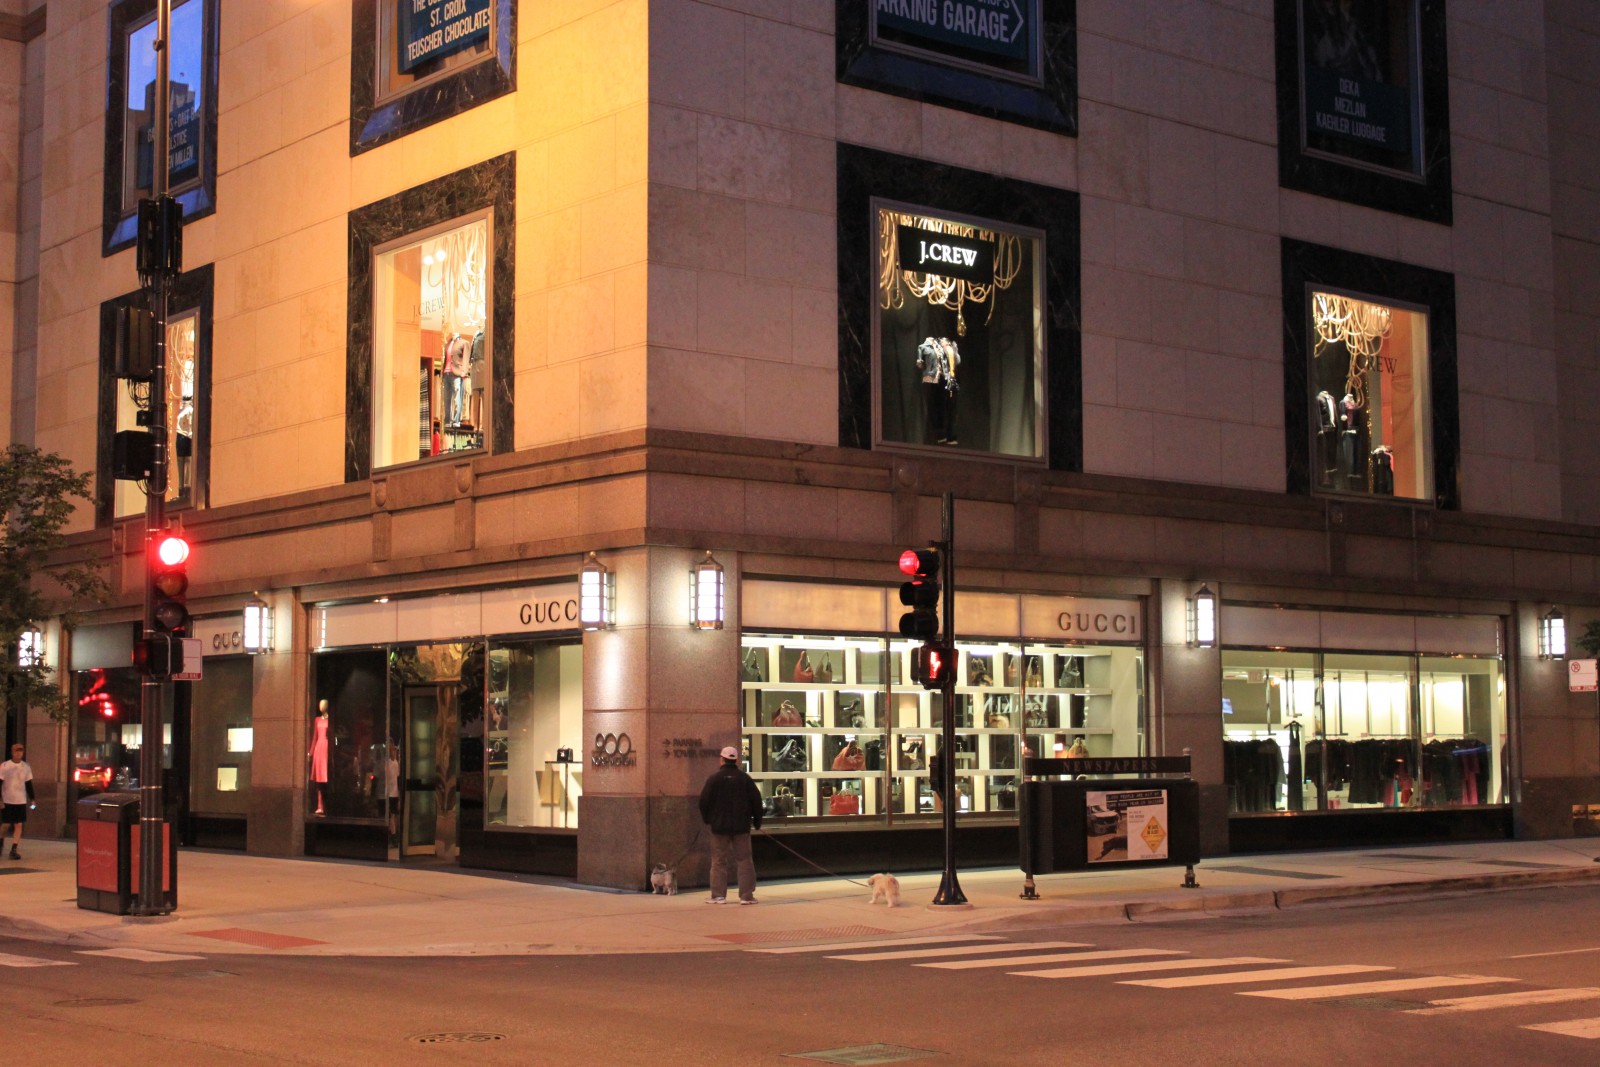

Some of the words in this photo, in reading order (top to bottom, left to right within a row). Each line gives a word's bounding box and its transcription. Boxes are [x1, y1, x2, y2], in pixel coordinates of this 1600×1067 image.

[430, 7, 442, 28] ST.
[444, 0, 467, 21] CROIX
[943, 0, 1009, 43] GARAGE
[407, 29, 443, 61] TEUSCHER
[444, 7, 491, 43] CHOCOLATES
[1334, 96, 1366, 118] MEZLAN
[1316, 112, 1350, 134] KAEHLER
[1351, 120, 1386, 143] LUGGAGE
[919, 241, 977, 267] J.CREW
[520, 599, 577, 625] GUCC
[1058, 611, 1136, 634] GUCCI
[213, 631, 241, 649] GUC
[1063, 760, 1157, 772] NEWSPAPERS
